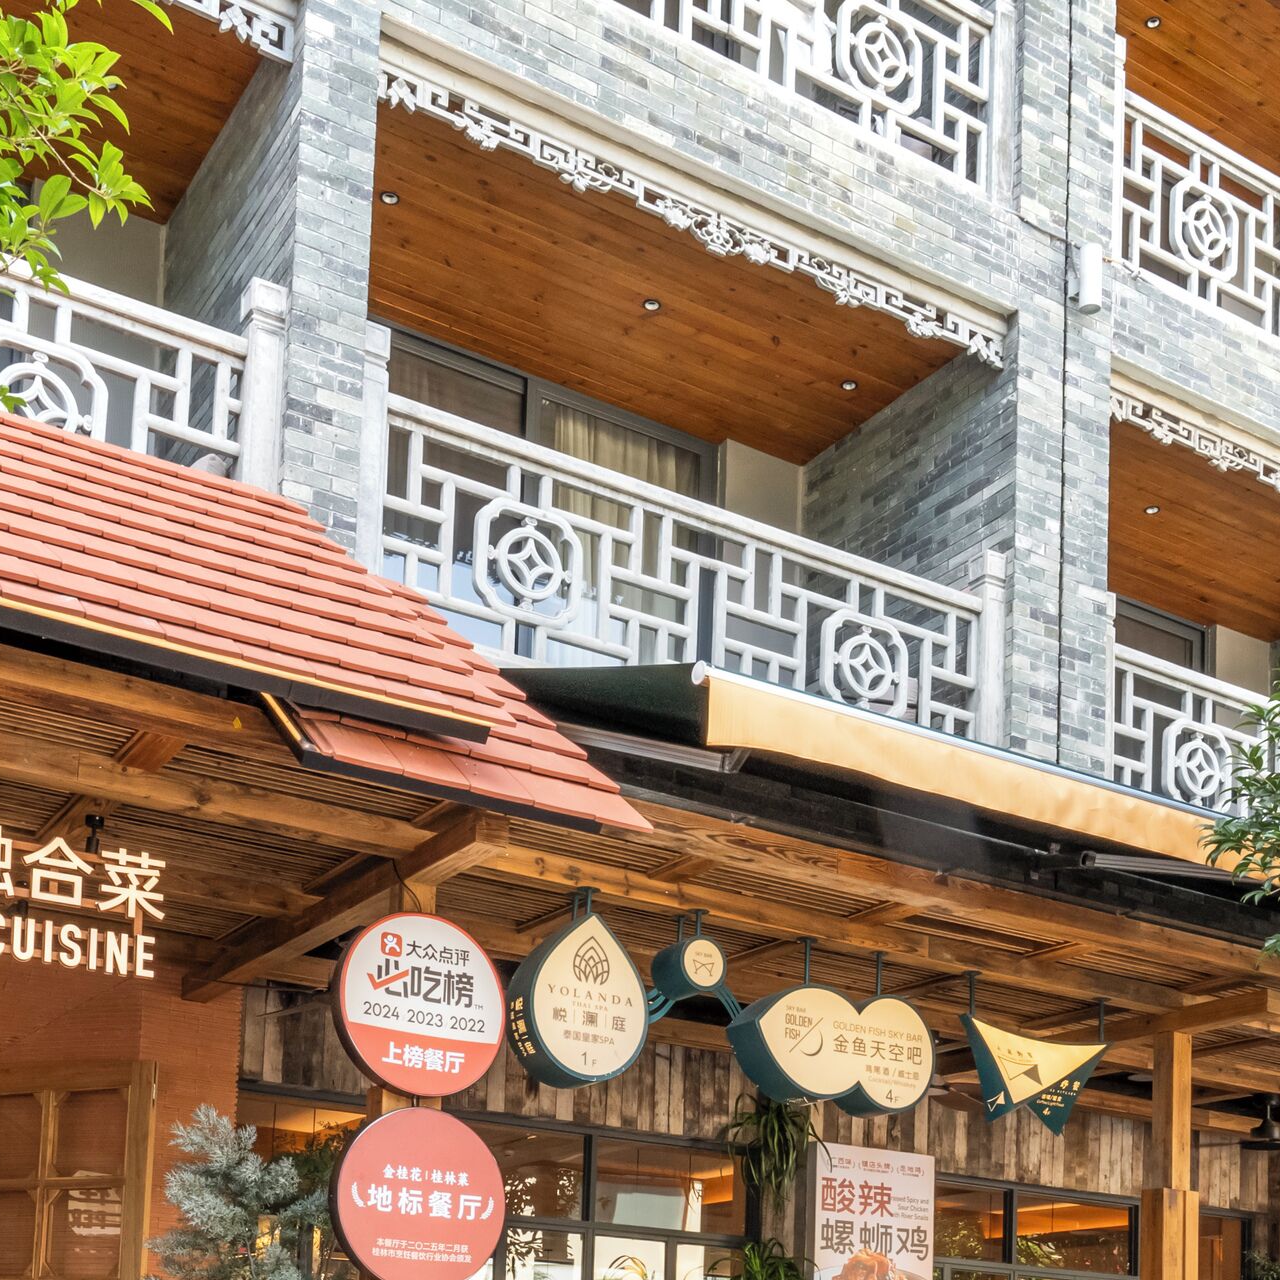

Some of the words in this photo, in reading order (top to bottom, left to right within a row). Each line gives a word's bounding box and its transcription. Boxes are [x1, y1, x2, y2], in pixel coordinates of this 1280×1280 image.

[406, 940, 470, 967] 大众点评
[367, 958, 474, 1010] 必吃榜
[548, 983, 633, 1007] YOLANDA
[363, 1001, 400, 1021] 2024
[407, 1009, 443, 1028] 2023
[450, 1016, 485, 1033] 2022
[785, 1013, 813, 1028] GOLDEN
[832, 1020, 867, 1034] GOLDEN
[869, 1026, 886, 1038] FISH
[888, 1029, 905, 1039] SKY
[906, 1033, 923, 1042] BAR
[785, 1027, 801, 1040] FISH
[833, 1033, 923, 1066] 金鱼天空吧
[382, 1041, 465, 1074] 上榜餐厅
[383, 1164, 422, 1182] 金桂花
[431, 1169, 470, 1187] 桂林菜
[367, 1183, 482, 1221] 地标餐厅
[821, 1176, 894, 1218] 酸辣
[820, 1217, 929, 1262] 螺蛳鸡
